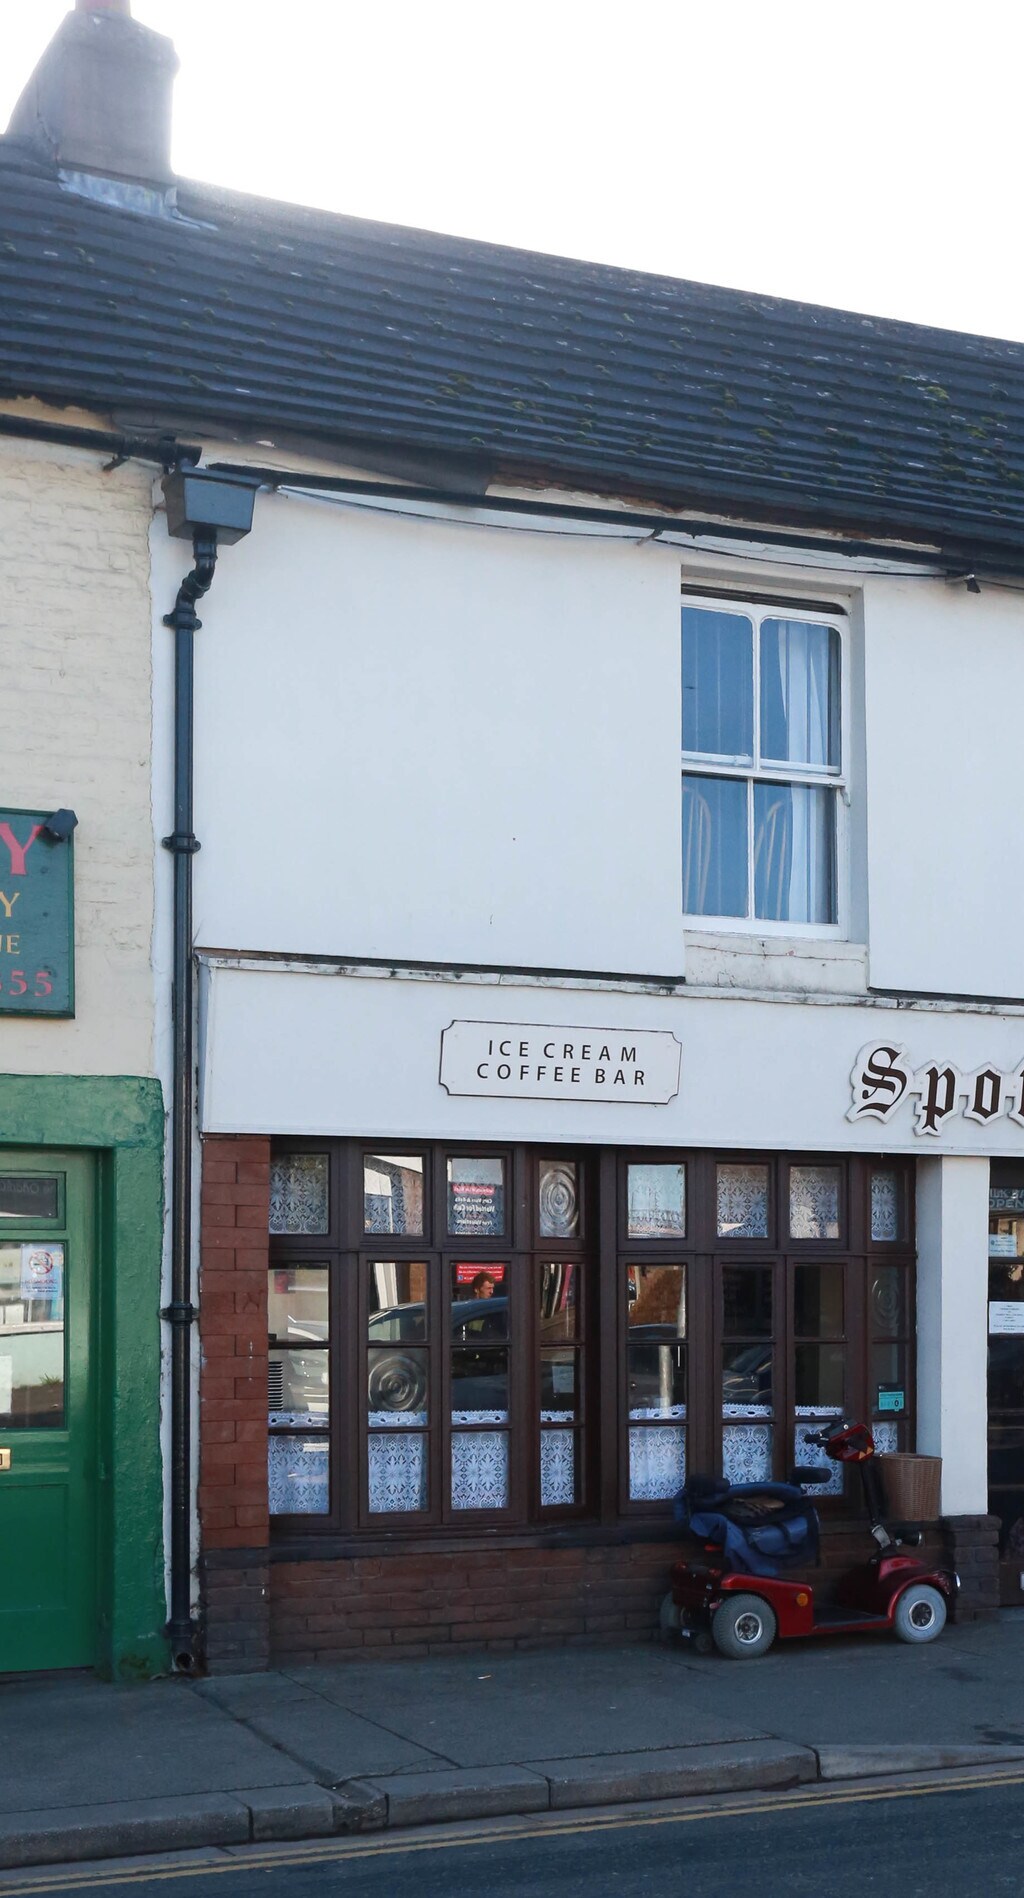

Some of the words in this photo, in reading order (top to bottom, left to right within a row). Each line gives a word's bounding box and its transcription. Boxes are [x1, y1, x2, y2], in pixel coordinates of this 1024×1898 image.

[0, 969, 52, 997] 55
[488, 1040, 530, 1057] ICE
[543, 1043, 637, 1062] CREAM
[476, 1063, 581, 1083] COFFEE
[594, 1068, 645, 1085] BAR
